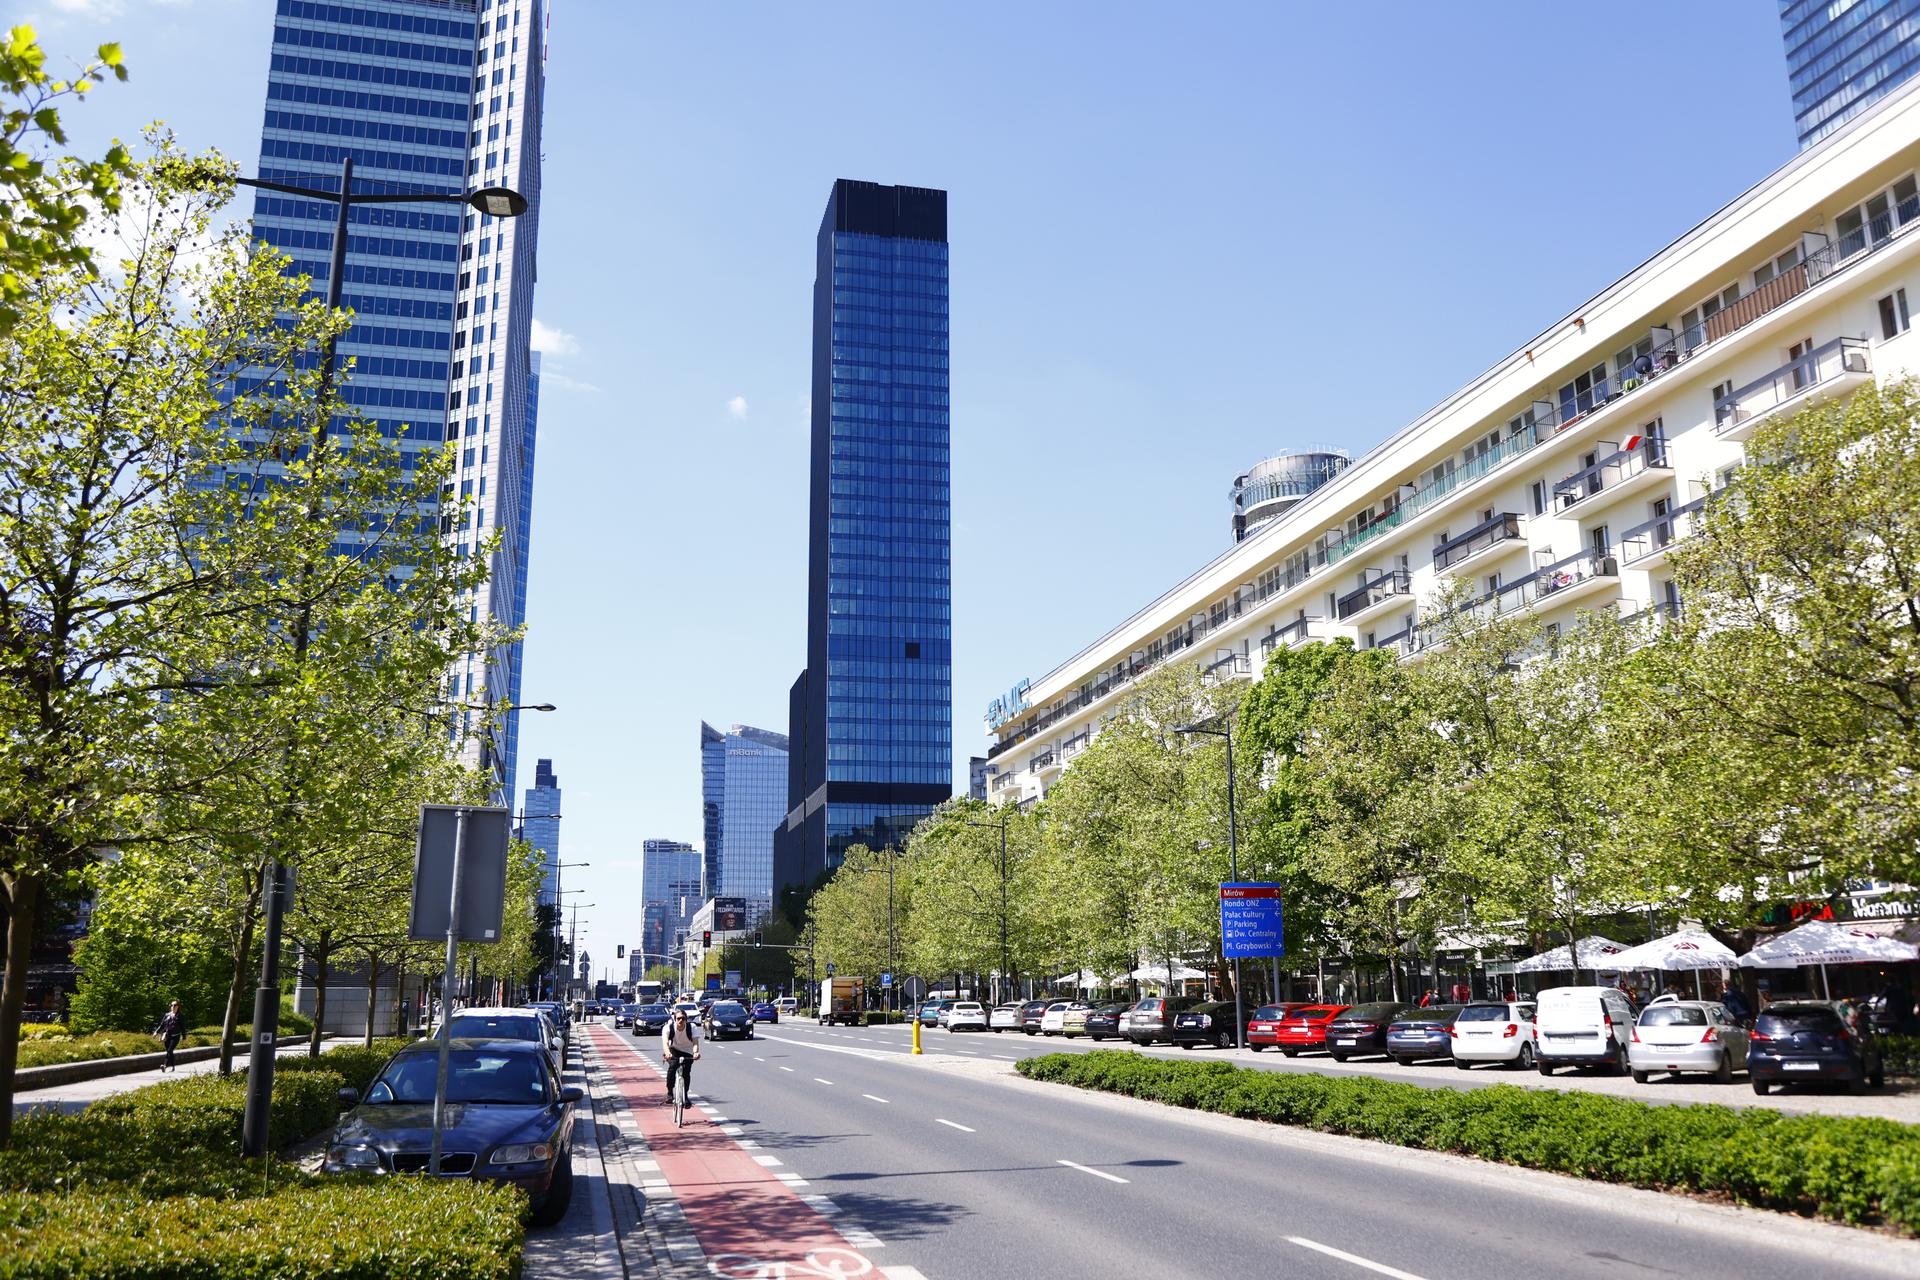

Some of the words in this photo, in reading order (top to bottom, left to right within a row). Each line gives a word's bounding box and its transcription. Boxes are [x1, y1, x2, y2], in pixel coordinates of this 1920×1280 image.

[729, 748, 763, 756] mBank
[1246, 899, 1260, 907] ONZ
[1851, 897, 1912, 918] Mamma
[1243, 911, 1265, 919] Kultury
[1234, 920, 1257, 929] Parking
[1234, 929, 1247, 937] Dw.
[1248, 929, 1277, 938] Centralny
[1226, 942, 1235, 950] Pl.
[1236, 942, 1272, 951] Grzybowski
